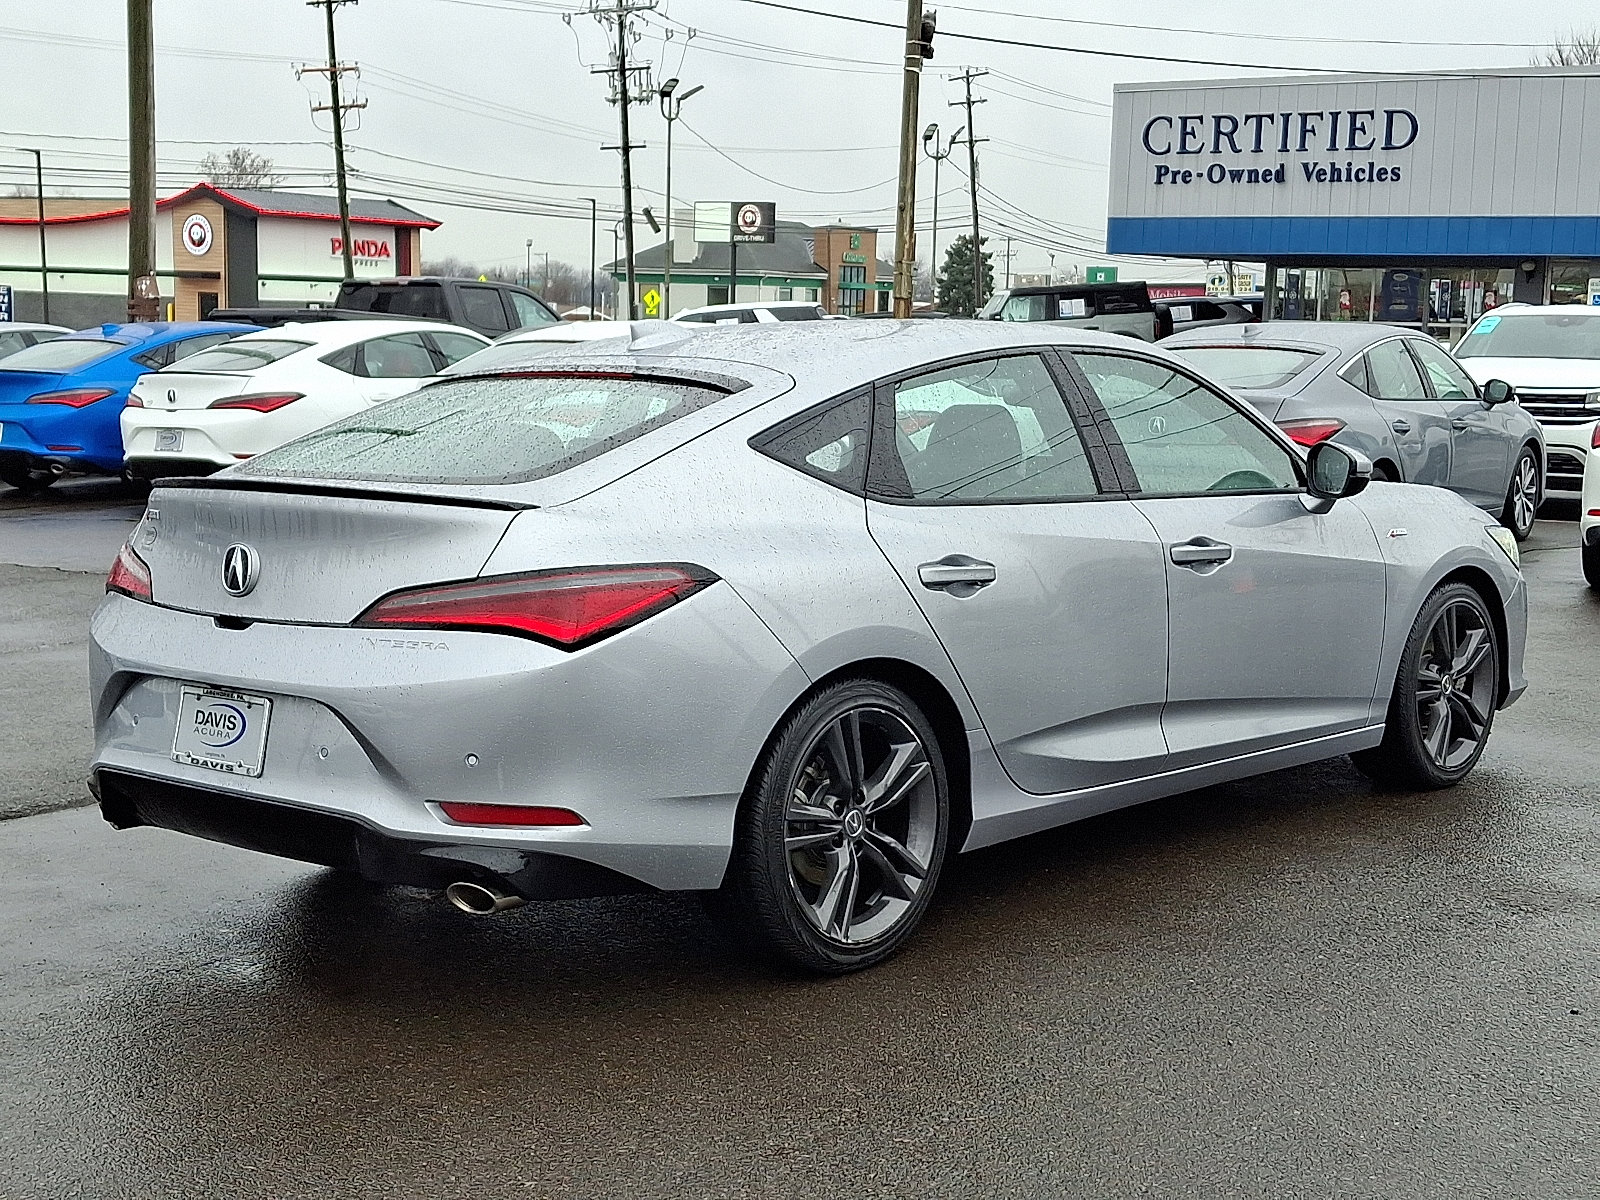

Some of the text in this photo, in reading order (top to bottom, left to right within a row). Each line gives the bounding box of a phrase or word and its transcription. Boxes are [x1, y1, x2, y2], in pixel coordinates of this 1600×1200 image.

[1142, 109, 1419, 155] CERTIFIED
[1154, 162, 1402, 185] Pre-Owned Vehicles
[194, 709, 237, 731] DAVIS
[193, 726, 231, 739] ACURA
[190, 758, 234, 772] DAVIS
